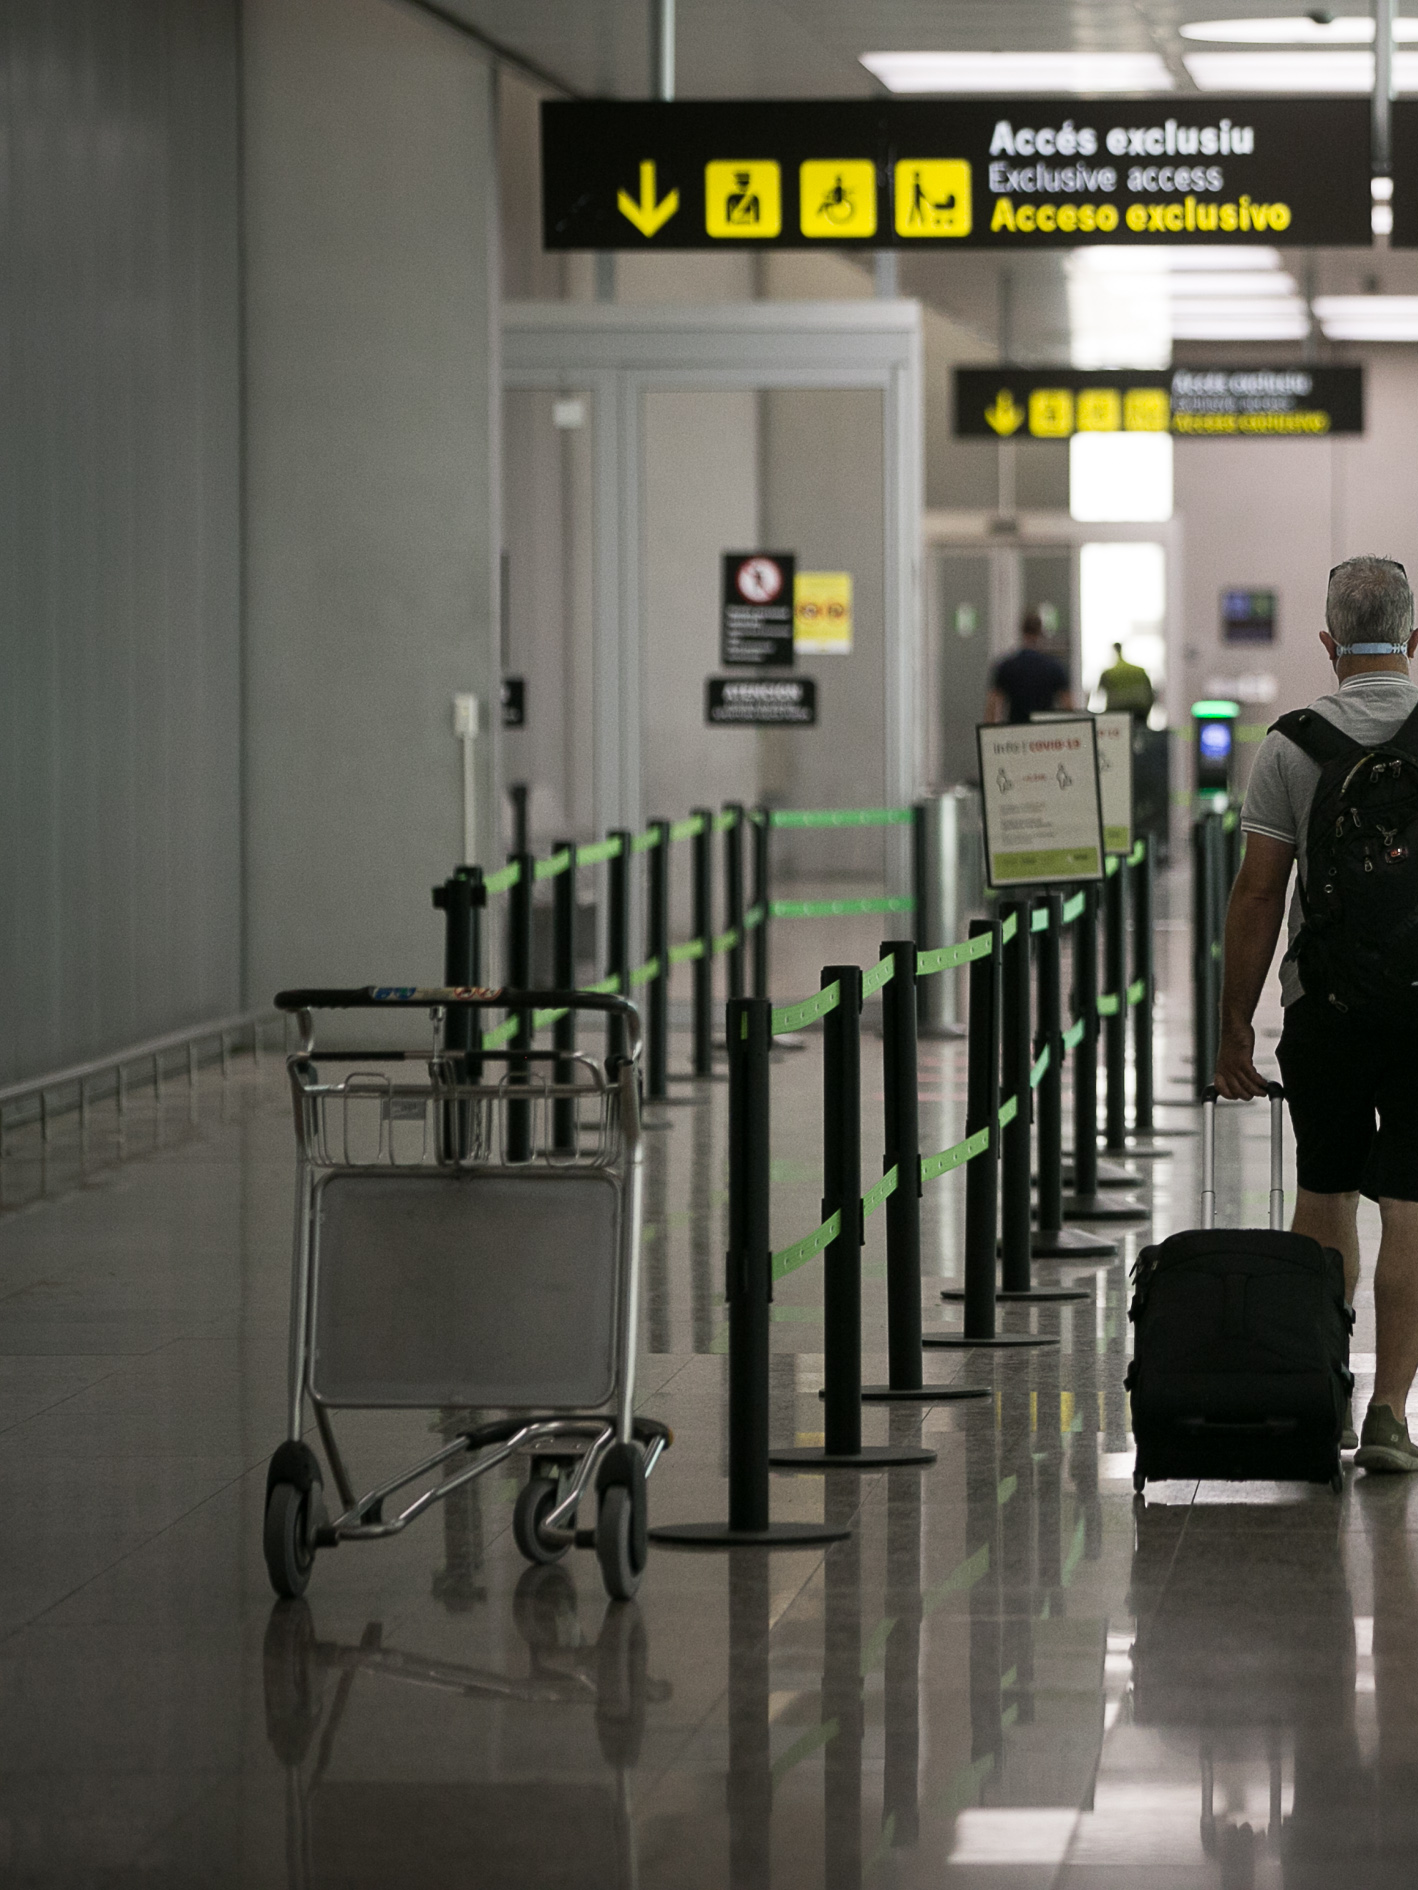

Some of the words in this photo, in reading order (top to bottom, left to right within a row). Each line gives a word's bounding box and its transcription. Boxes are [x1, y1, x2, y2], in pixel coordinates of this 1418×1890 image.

[989, 118, 1098, 156] Accés
[1106, 118, 1254, 156] exclusiu
[988, 160, 1117, 193] Exclusive
[1127, 165, 1224, 192] access
[990, 197, 1119, 232] Acceso
[1126, 194, 1292, 232] exclusivo
